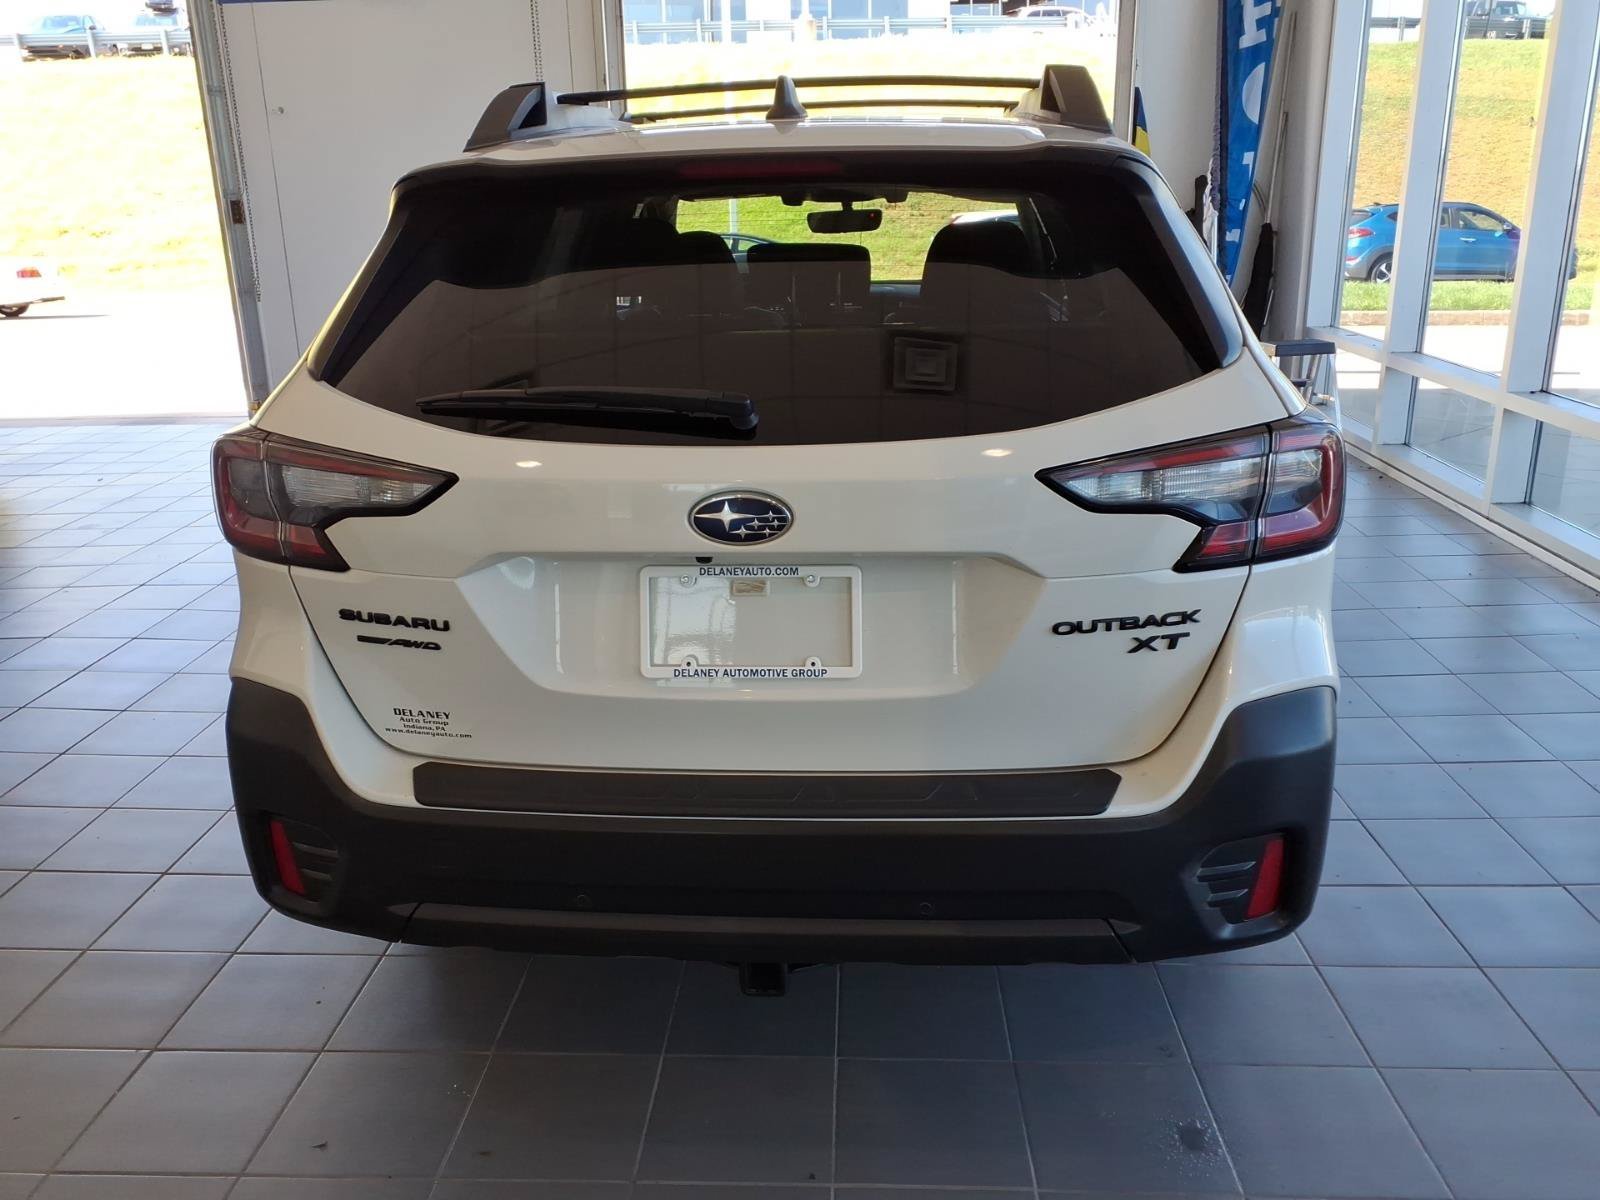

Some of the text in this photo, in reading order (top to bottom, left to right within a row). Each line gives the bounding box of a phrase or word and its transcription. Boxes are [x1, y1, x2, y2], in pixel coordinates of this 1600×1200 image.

[699, 567, 799, 577] DELANEYAUTO.COM
[338, 608, 451, 632] SUBARU
[1052, 609, 1202, 636] OUTBACK
[388, 638, 442, 651] AWD
[1127, 632, 1190, 654] XT
[673, 668, 828, 678] DELANEY AUTOMOTIVE GROUP
[393, 707, 451, 719] DELANEY
[423, 719, 449, 727] Group
[385, 727, 472, 738] www.delaneyauto.com
